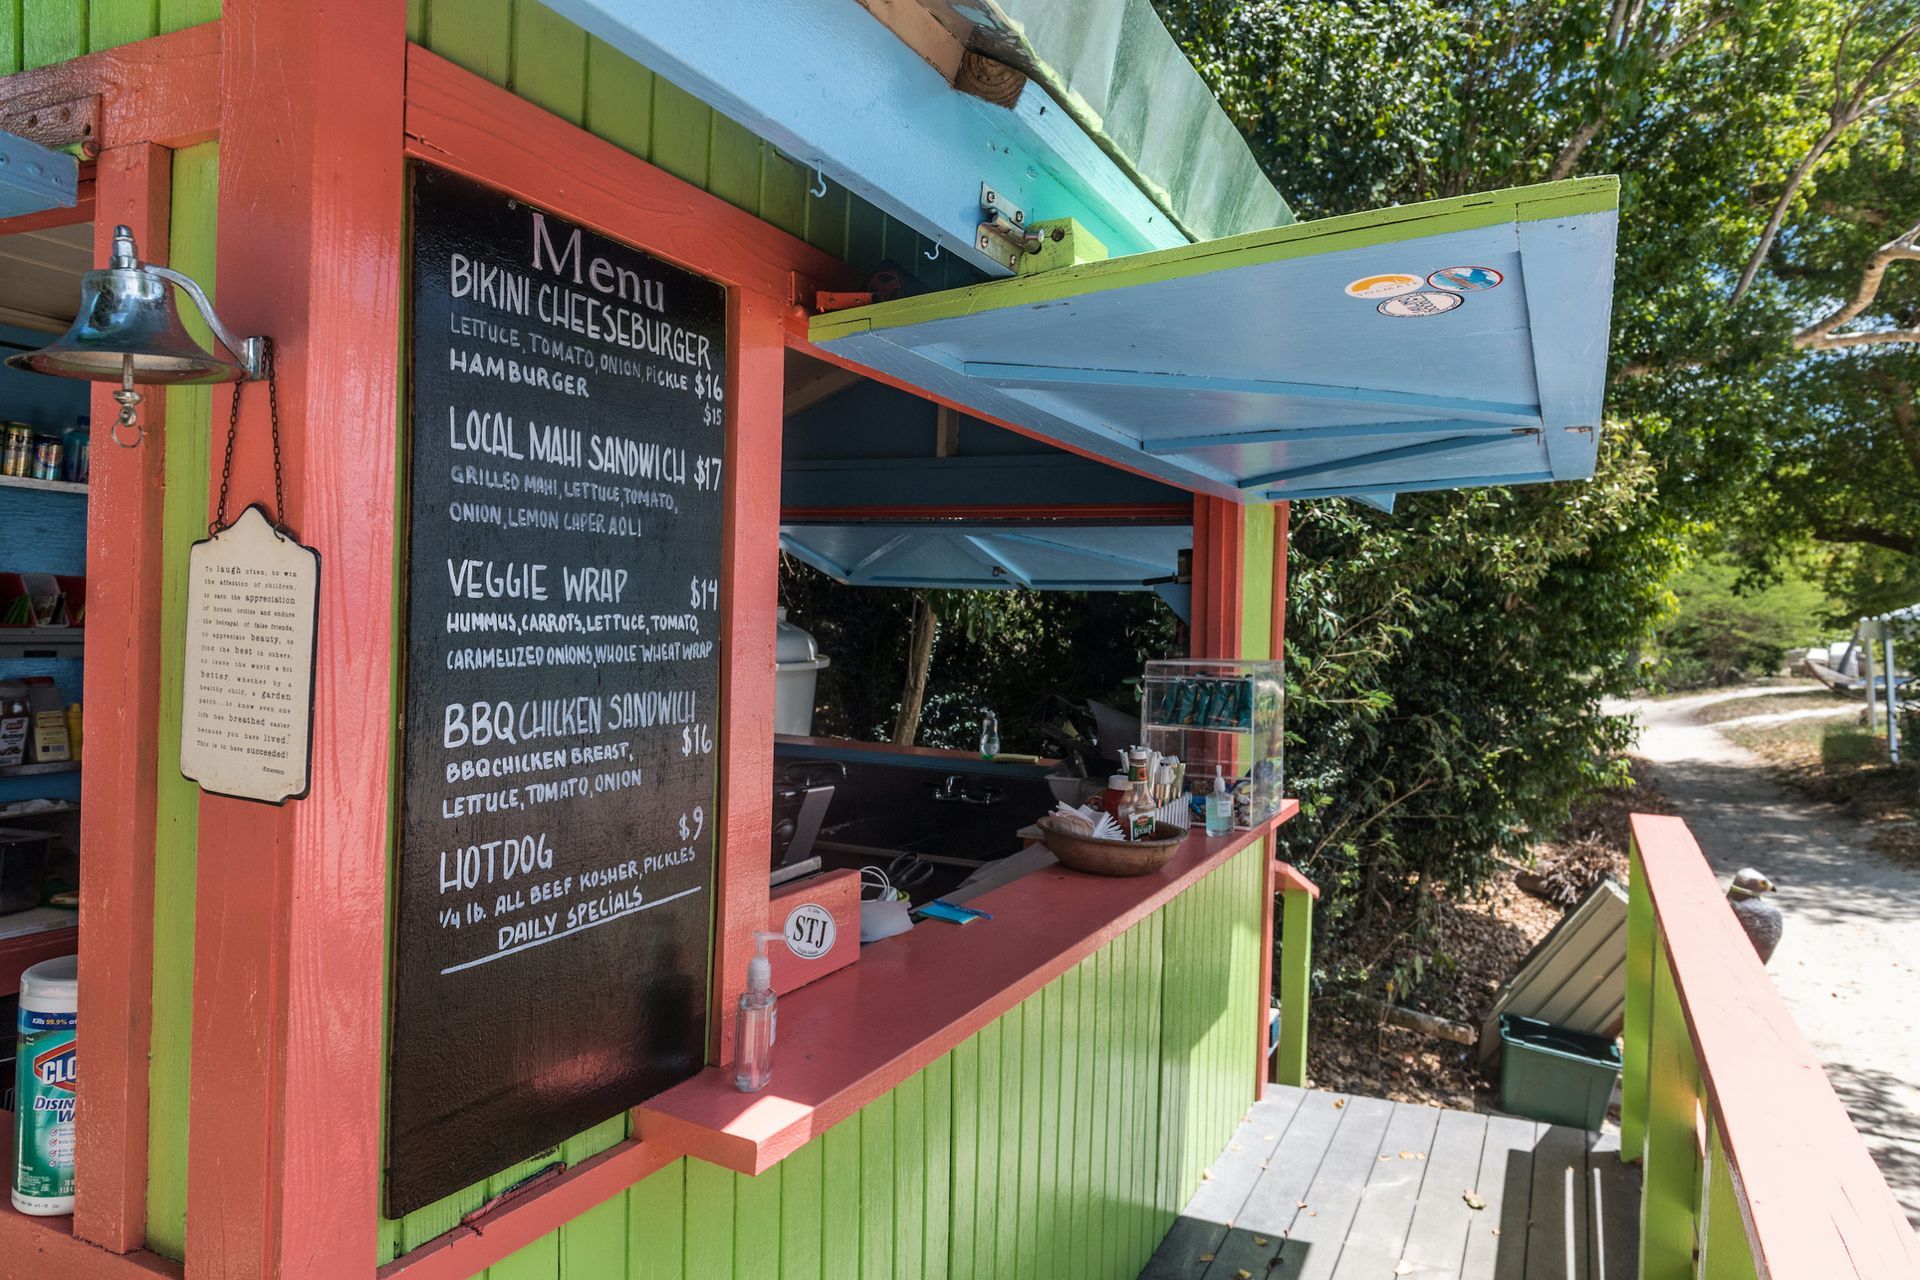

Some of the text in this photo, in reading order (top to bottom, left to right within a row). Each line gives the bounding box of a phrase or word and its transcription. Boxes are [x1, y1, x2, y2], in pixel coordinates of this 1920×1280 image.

[532, 213, 664, 312] Menu
[451, 254, 711, 370] BIKINI CHEESEBURGER
[450, 348, 589, 398] HAMBURGER
[694, 370, 722, 400] $16
[704, 402, 722, 426] $15
[450, 406, 721, 490] LOCAL MAHI SANDWICH $17
[451, 466, 520, 490] GRILLED
[508, 508, 558, 530] LEMON
[564, 513, 604, 533] CAPER
[216, 566, 241, 574] laugh
[220, 579, 248, 587] affection
[448, 559, 628, 602] VEGGIE WRAP
[245, 595, 295, 604] appreciation
[691, 576, 718, 610] $14
[235, 647, 252, 655] best
[447, 646, 544, 670] CARAMELIZED
[596, 644, 636, 664] WHOLE
[639, 642, 680, 662] WHEAT
[682, 640, 712, 660] WRAP
[200, 685, 222, 693] healthy
[262, 691, 291, 700] garden
[237, 677, 266, 685] whether
[229, 714, 265, 726] breathed
[444, 690, 696, 748] BBQ CHICKEN SANDWICH
[682, 724, 712, 757] $16
[446, 759, 489, 783] BBQ
[492, 749, 566, 777] CHICKEN
[596, 769, 642, 792] ONION
[440, 909, 460, 929] 1/4
[495, 890, 524, 917] ALL
[530, 877, 572, 905] BEEF
[644, 846, 696, 874] PICKLES
[499, 912, 558, 950] DAILY
[793, 915, 828, 948] STJ
